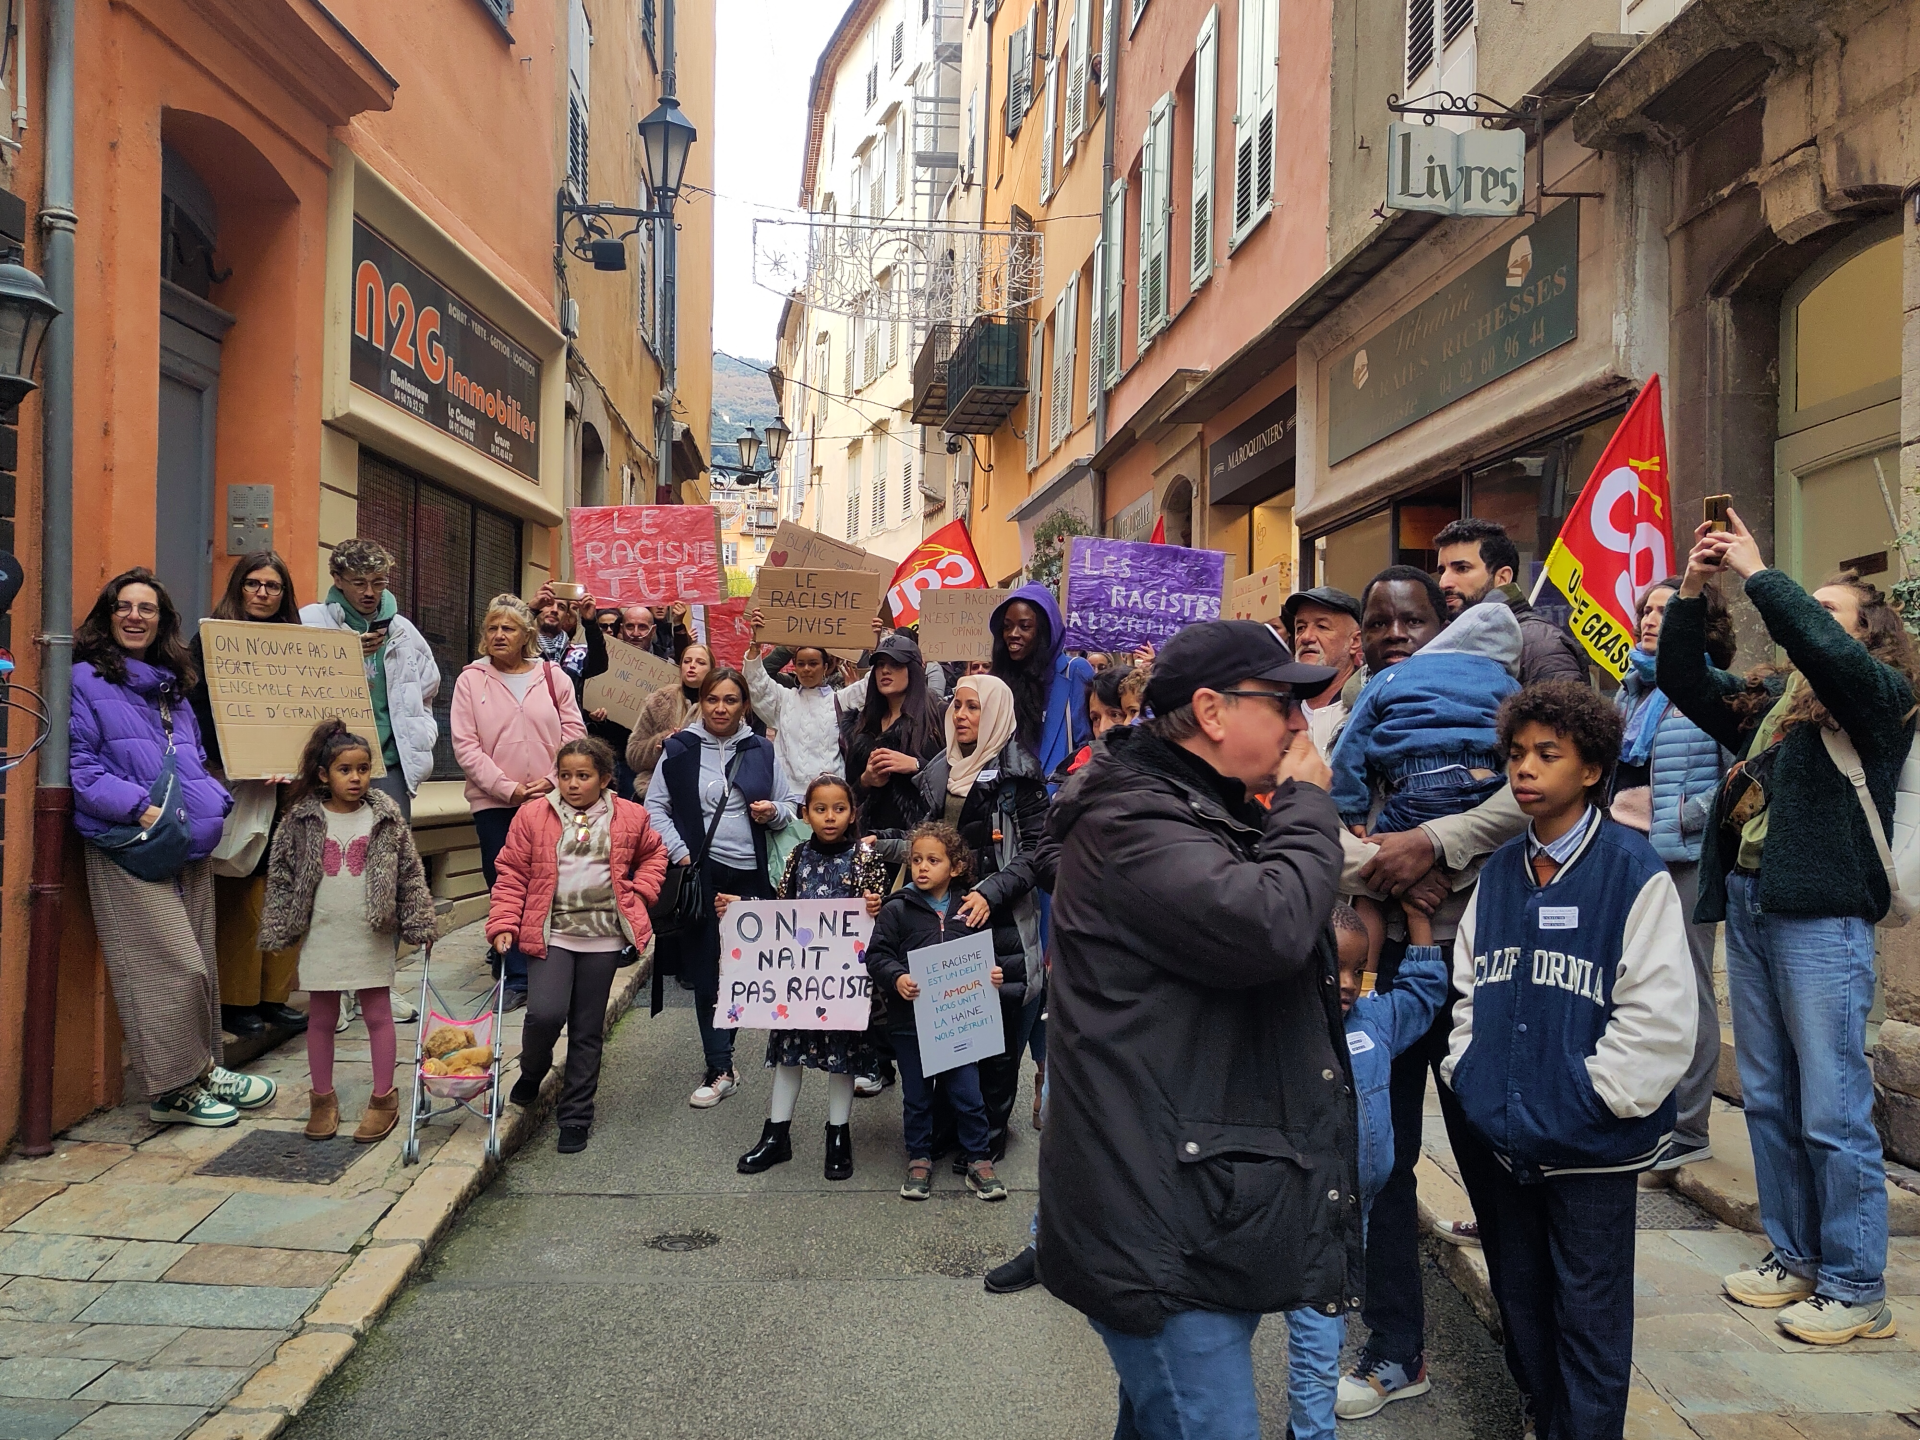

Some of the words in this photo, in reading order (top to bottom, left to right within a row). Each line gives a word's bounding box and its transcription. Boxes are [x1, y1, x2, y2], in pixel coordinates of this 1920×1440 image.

[1397, 131, 1518, 206] Livres
[1442, 265, 1568, 362] RICHESSES
[1504, 331, 1519, 363] 96
[446, 356, 536, 443] Immobilier
[1227, 420, 1284, 472] MAROQUINIERS
[613, 509, 661, 535] LE
[585, 539, 717, 568] RACISME
[1084, 548, 1132, 579] LES
[596, 565, 700, 600] TUE
[795, 572, 819, 589] LE
[770, 590, 862, 609] RACISME
[935, 592, 956, 605] LE
[1111, 586, 1221, 618] RACISTES
[787, 616, 848, 635] DIVISE
[960, 610, 984, 625] PAS
[952, 626, 983, 637] OPINION
[1581, 613, 1630, 673] GRASS
[215, 635, 240, 653] ON
[246, 637, 303, 657] N'OUVRE
[308, 641, 328, 659] PAS
[333, 646, 348, 660] LA
[956, 642, 972, 656] UN
[215, 656, 260, 677] PORTE
[268, 663, 287, 676] DU
[614, 668, 634, 683] UNE
[219, 677, 294, 698] ENSEMBLE
[301, 686, 335, 699] AVEC
[340, 686, 366, 700] UNE
[601, 685, 616, 700] UN
[226, 703, 256, 718] CLE
[736, 909, 798, 944] ON
[818, 910, 860, 939] NE
[758, 946, 830, 971] NAIT
[926, 962, 939, 975] LE
[941, 950, 982, 970] RACISME
[731, 979, 777, 1004] PAS
[787, 974, 874, 1003] RACISTE
[927, 974, 944, 987] EST
[945, 970, 958, 981] UN
[933, 1018, 948, 1029] LA
[951, 1005, 984, 1024] HAINE
[935, 1001, 957, 1014] NOUS
[934, 1029, 955, 1042] NOUS
